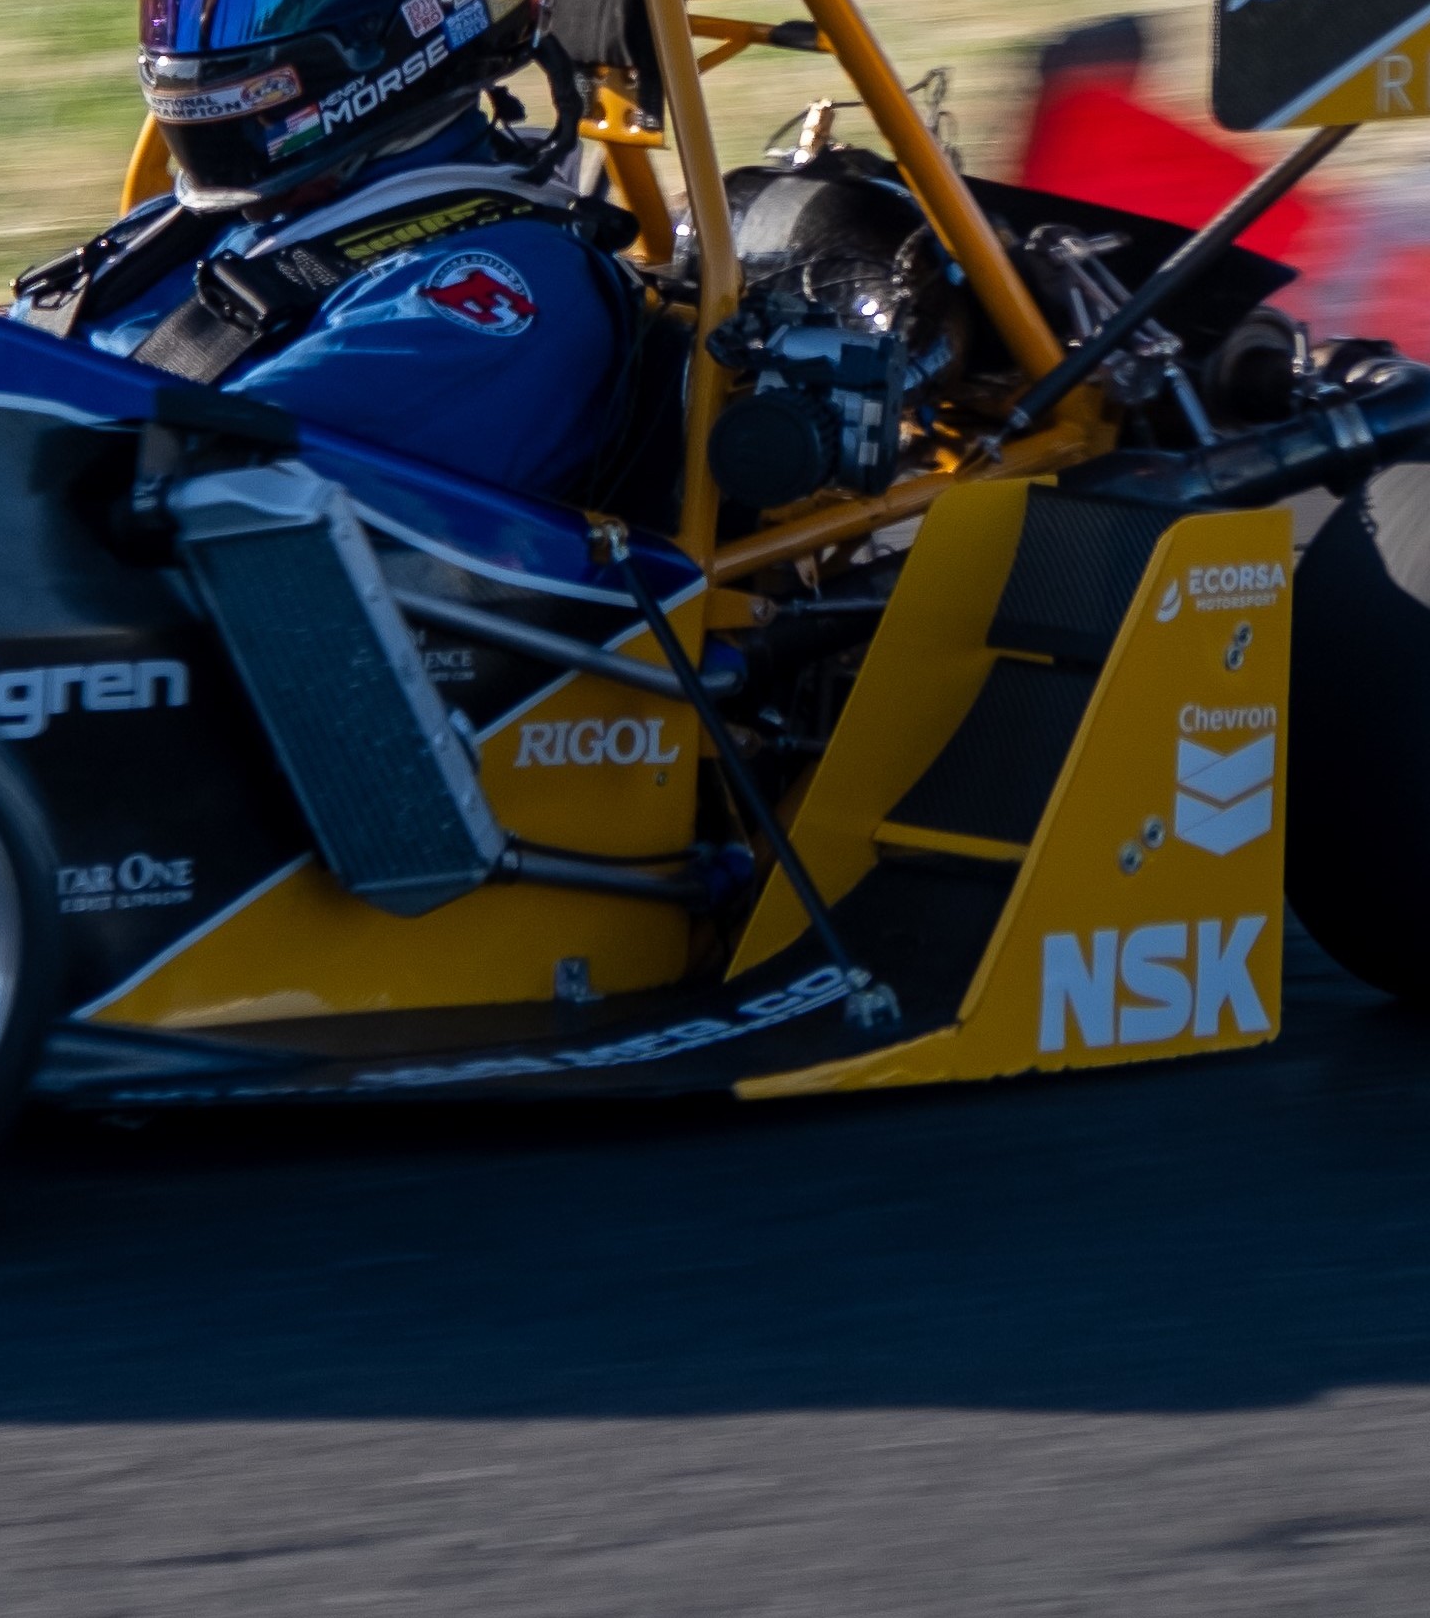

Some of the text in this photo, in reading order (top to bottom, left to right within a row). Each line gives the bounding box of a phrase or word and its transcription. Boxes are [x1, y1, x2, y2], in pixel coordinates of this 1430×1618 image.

[321, 35, 449, 135] MORSE
[1188, 562, 1287, 595] ECORSA
[514, 717, 680, 770] RIGOL
[1178, 702, 1277, 732] Chevron
[1038, 914, 1271, 1054] NSK
